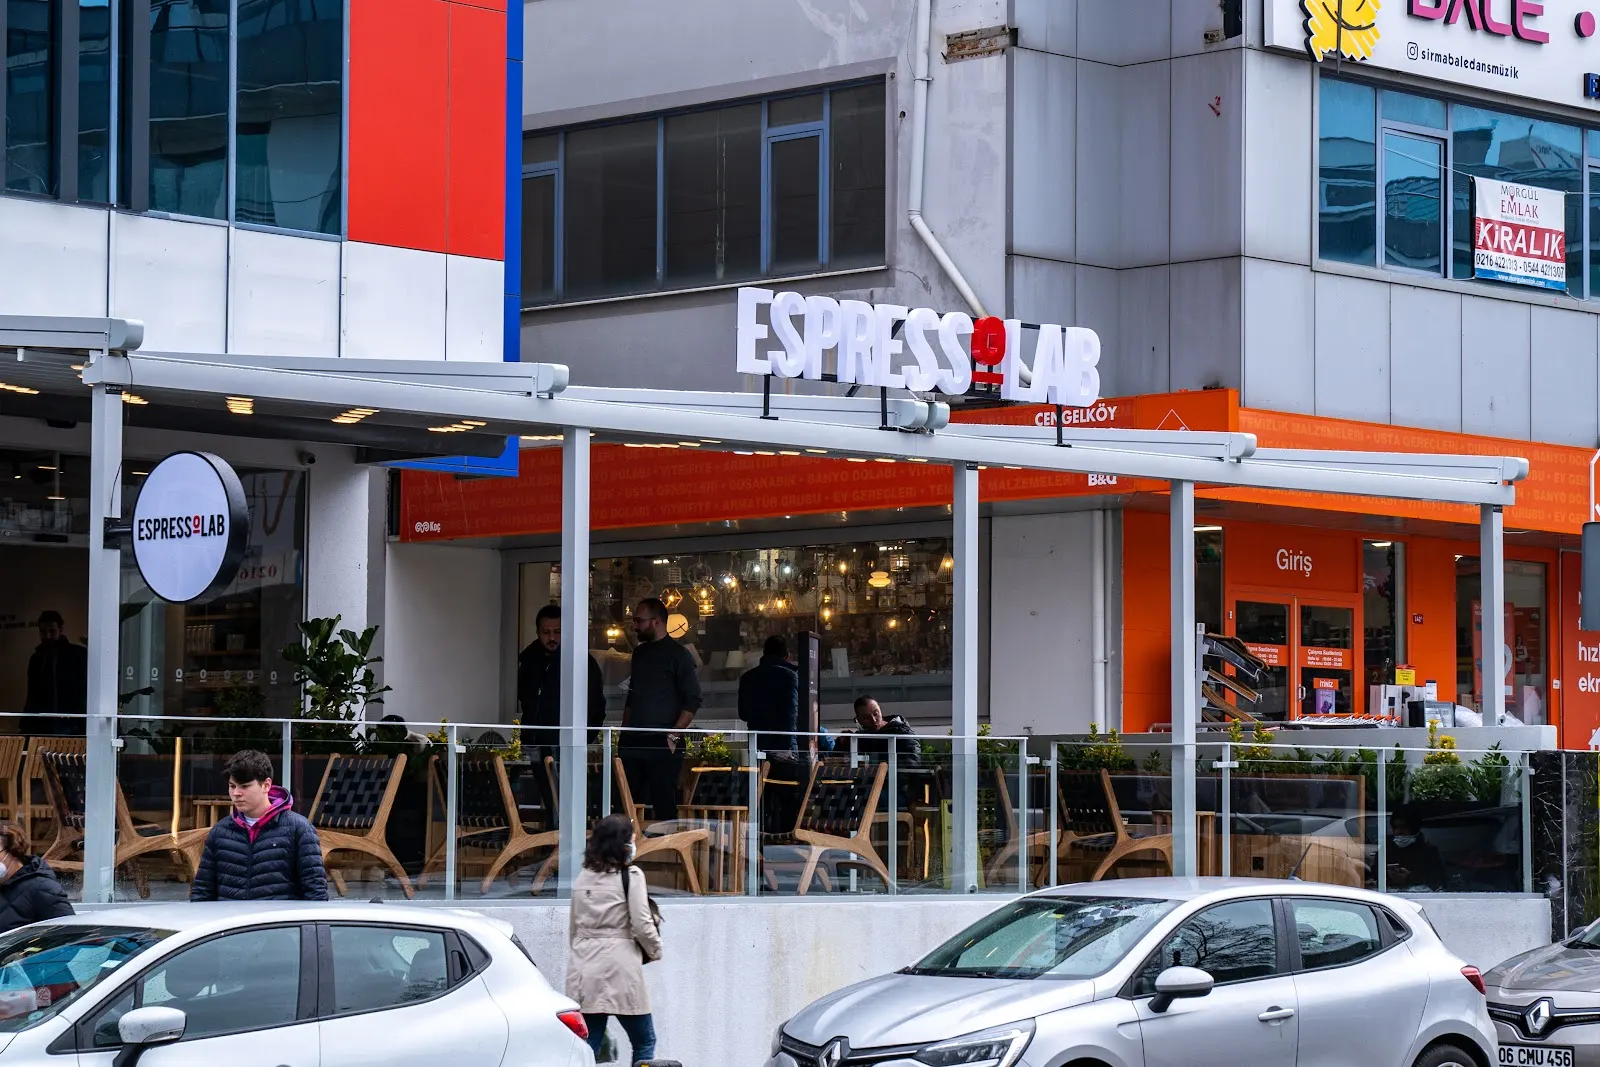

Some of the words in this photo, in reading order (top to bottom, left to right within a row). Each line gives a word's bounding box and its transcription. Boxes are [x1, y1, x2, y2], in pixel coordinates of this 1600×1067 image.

[1501, 200, 1539, 218] EMLAK
[1475, 253, 1494, 267] 0216
[1523, 261, 1540, 274] 0544
[736, 287, 1101, 407] ESPRESSOLAB
[138, 514, 225, 541] ESPRESSOLAB
[1276, 548, 1313, 578] Giriş
[1498, 1047, 1514, 1064] 06
[1517, 1048, 1545, 1066] CMU
[1546, 1050, 1571, 1067] 456
